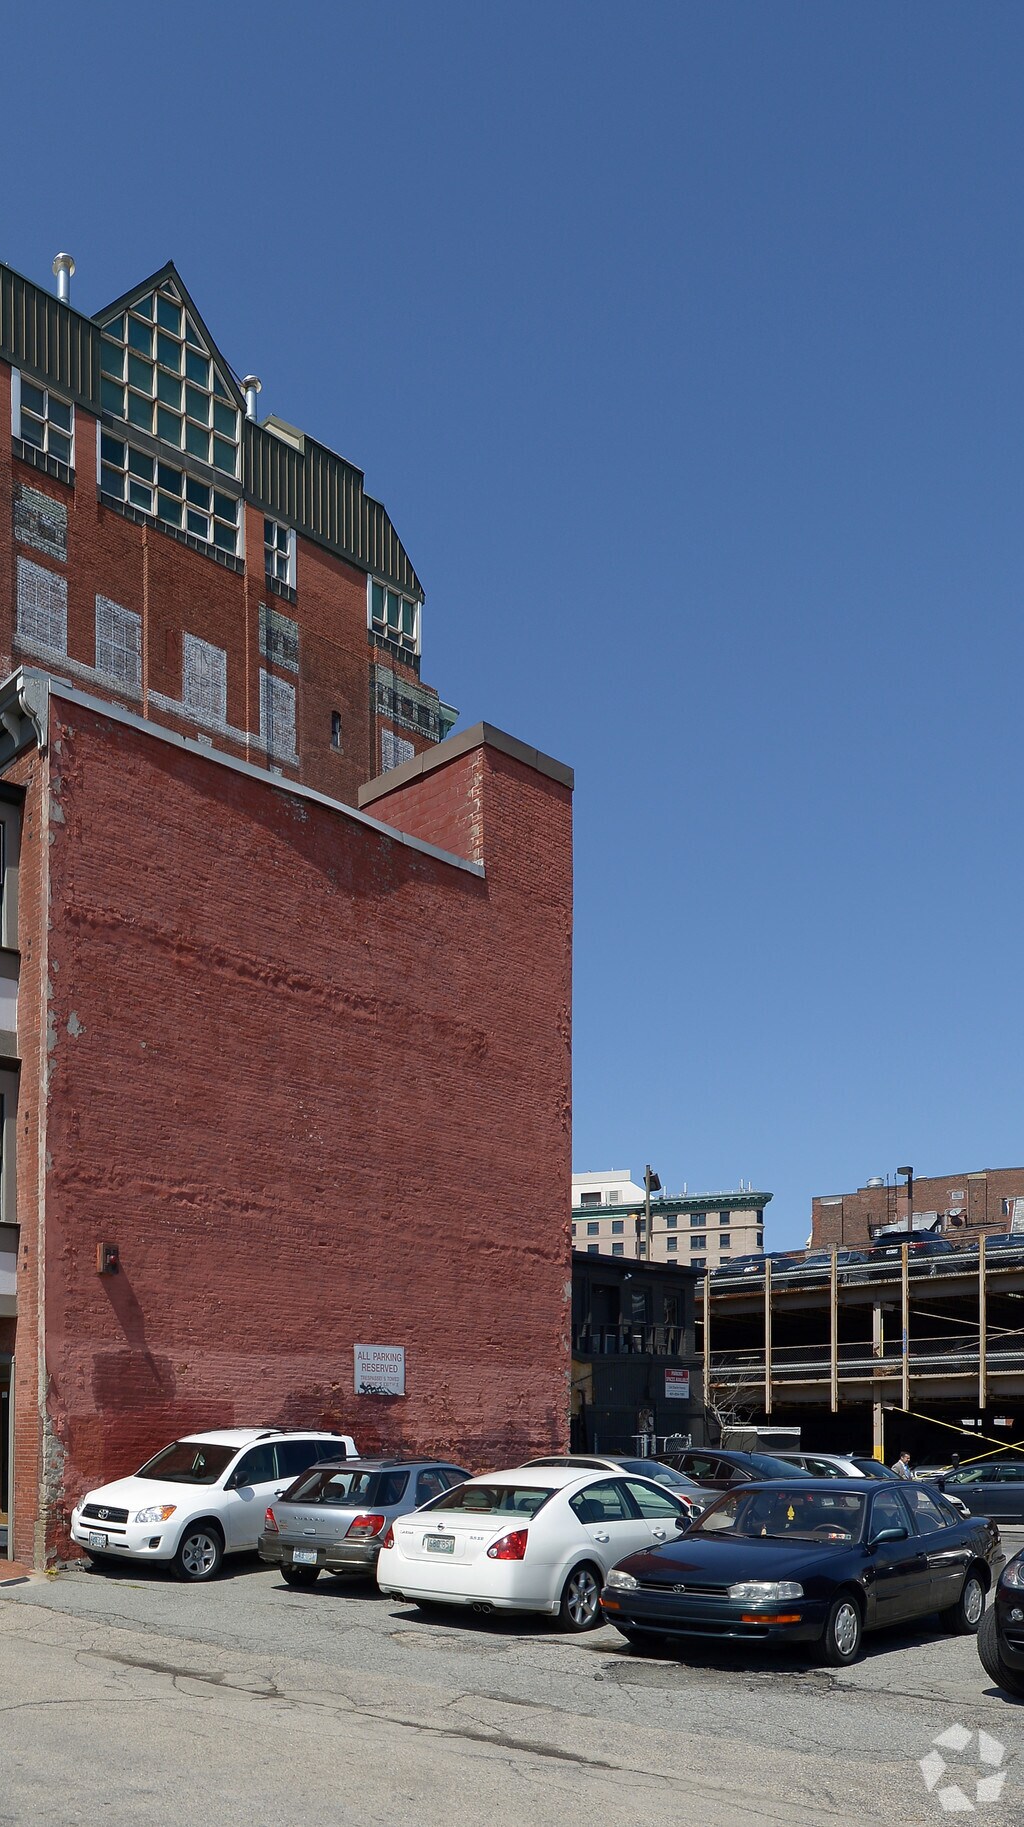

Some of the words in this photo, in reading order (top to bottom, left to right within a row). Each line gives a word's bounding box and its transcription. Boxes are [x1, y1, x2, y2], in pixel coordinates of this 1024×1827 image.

[357, 1351, 370, 1361] ALL
[372, 1352, 402, 1362] PARKING
[361, 1363, 398, 1373] RESERVED
